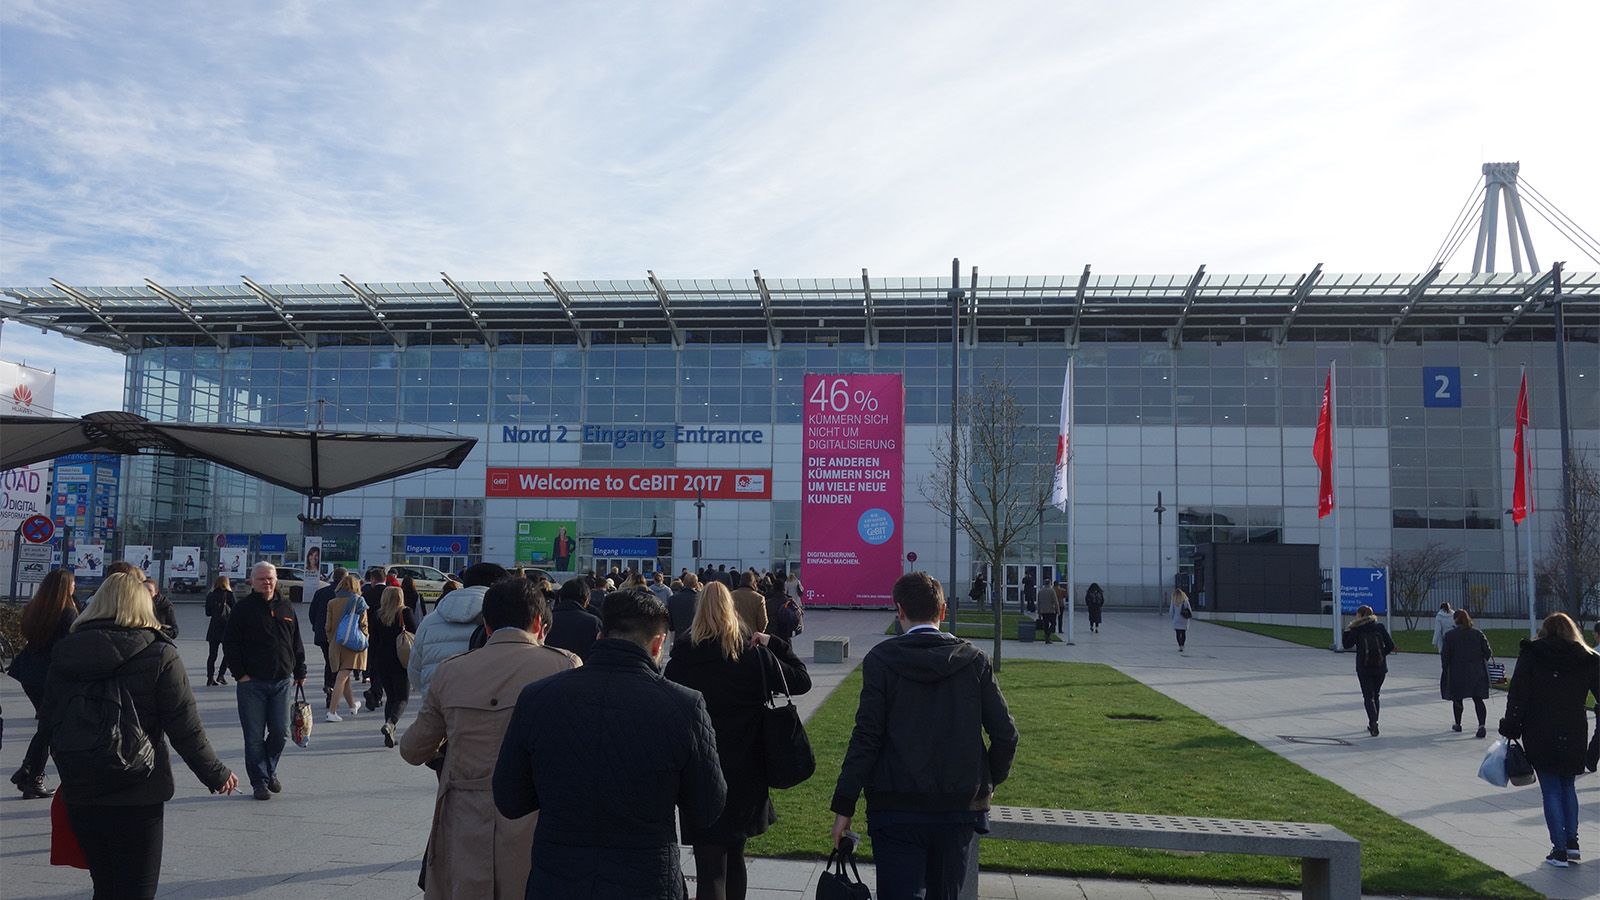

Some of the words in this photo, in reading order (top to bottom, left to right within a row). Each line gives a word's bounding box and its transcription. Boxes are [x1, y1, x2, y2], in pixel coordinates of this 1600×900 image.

[1435, 375, 1450, 398] 2
[810, 379, 849, 412] 46
[854, 390, 878, 412] %
[809, 413, 861, 425] KÜMMERN
[864, 415, 889, 425] SICH
[503, 425, 550, 443] Nord
[557, 426, 568, 443] 2
[583, 425, 666, 449] Eingang
[675, 426, 763, 444] Entrance
[809, 427, 840, 437] NICHT
[843, 428, 859, 437] UM
[809, 440, 896, 450] DIGITALISIERUNG
[809, 457, 826, 466] DIE
[829, 457, 880, 467] ANDEREN
[808, 468, 862, 479] KÜMMERN
[865, 470, 890, 479] SICH
[0, 470, 40, 493] OAD
[519, 473, 601, 491] Welcome
[605, 475, 624, 490] to
[629, 475, 679, 491] CeBIT
[684, 475, 722, 491] 2017
[808, 482, 825, 491] UM
[827, 482, 855, 491] VIELE
[858, 482, 887, 492] NEUE
[808, 495, 852, 504] KUNDEN
[9, 499, 38, 513] DIGITAL
[407, 544, 431, 553] Eingang
[594, 547, 619, 556] Eingang
